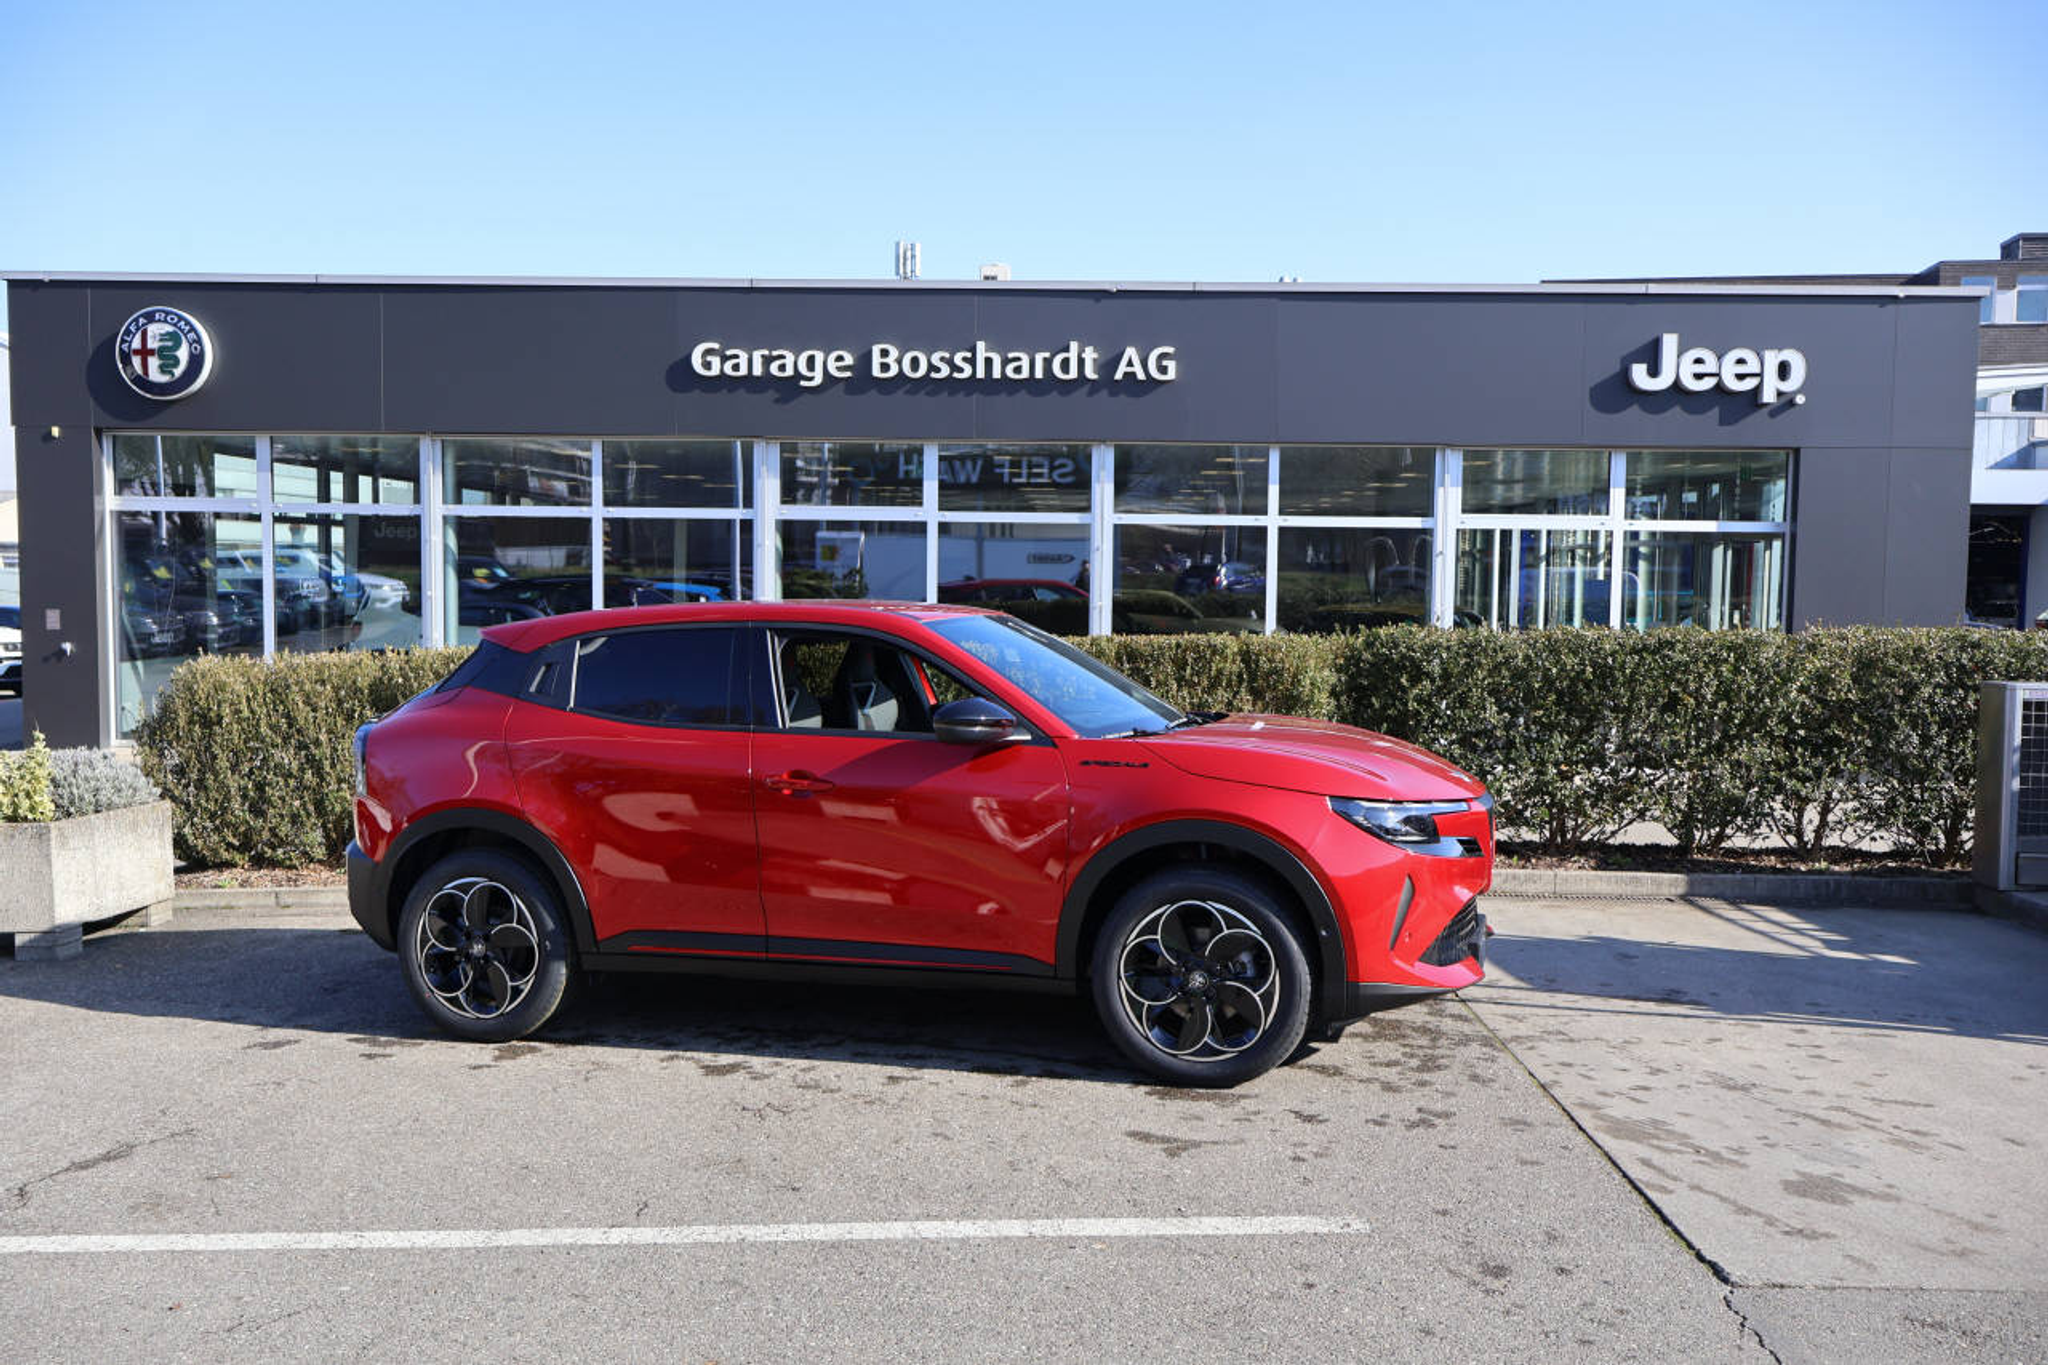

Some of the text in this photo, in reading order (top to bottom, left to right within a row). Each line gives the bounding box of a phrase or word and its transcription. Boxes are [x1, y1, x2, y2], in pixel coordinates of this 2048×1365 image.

[121, 312, 201, 355] ALFA ROMEO
[691, 341, 1178, 388] Garage Bosshardt AG
[1629, 332, 1807, 405] Jeep
